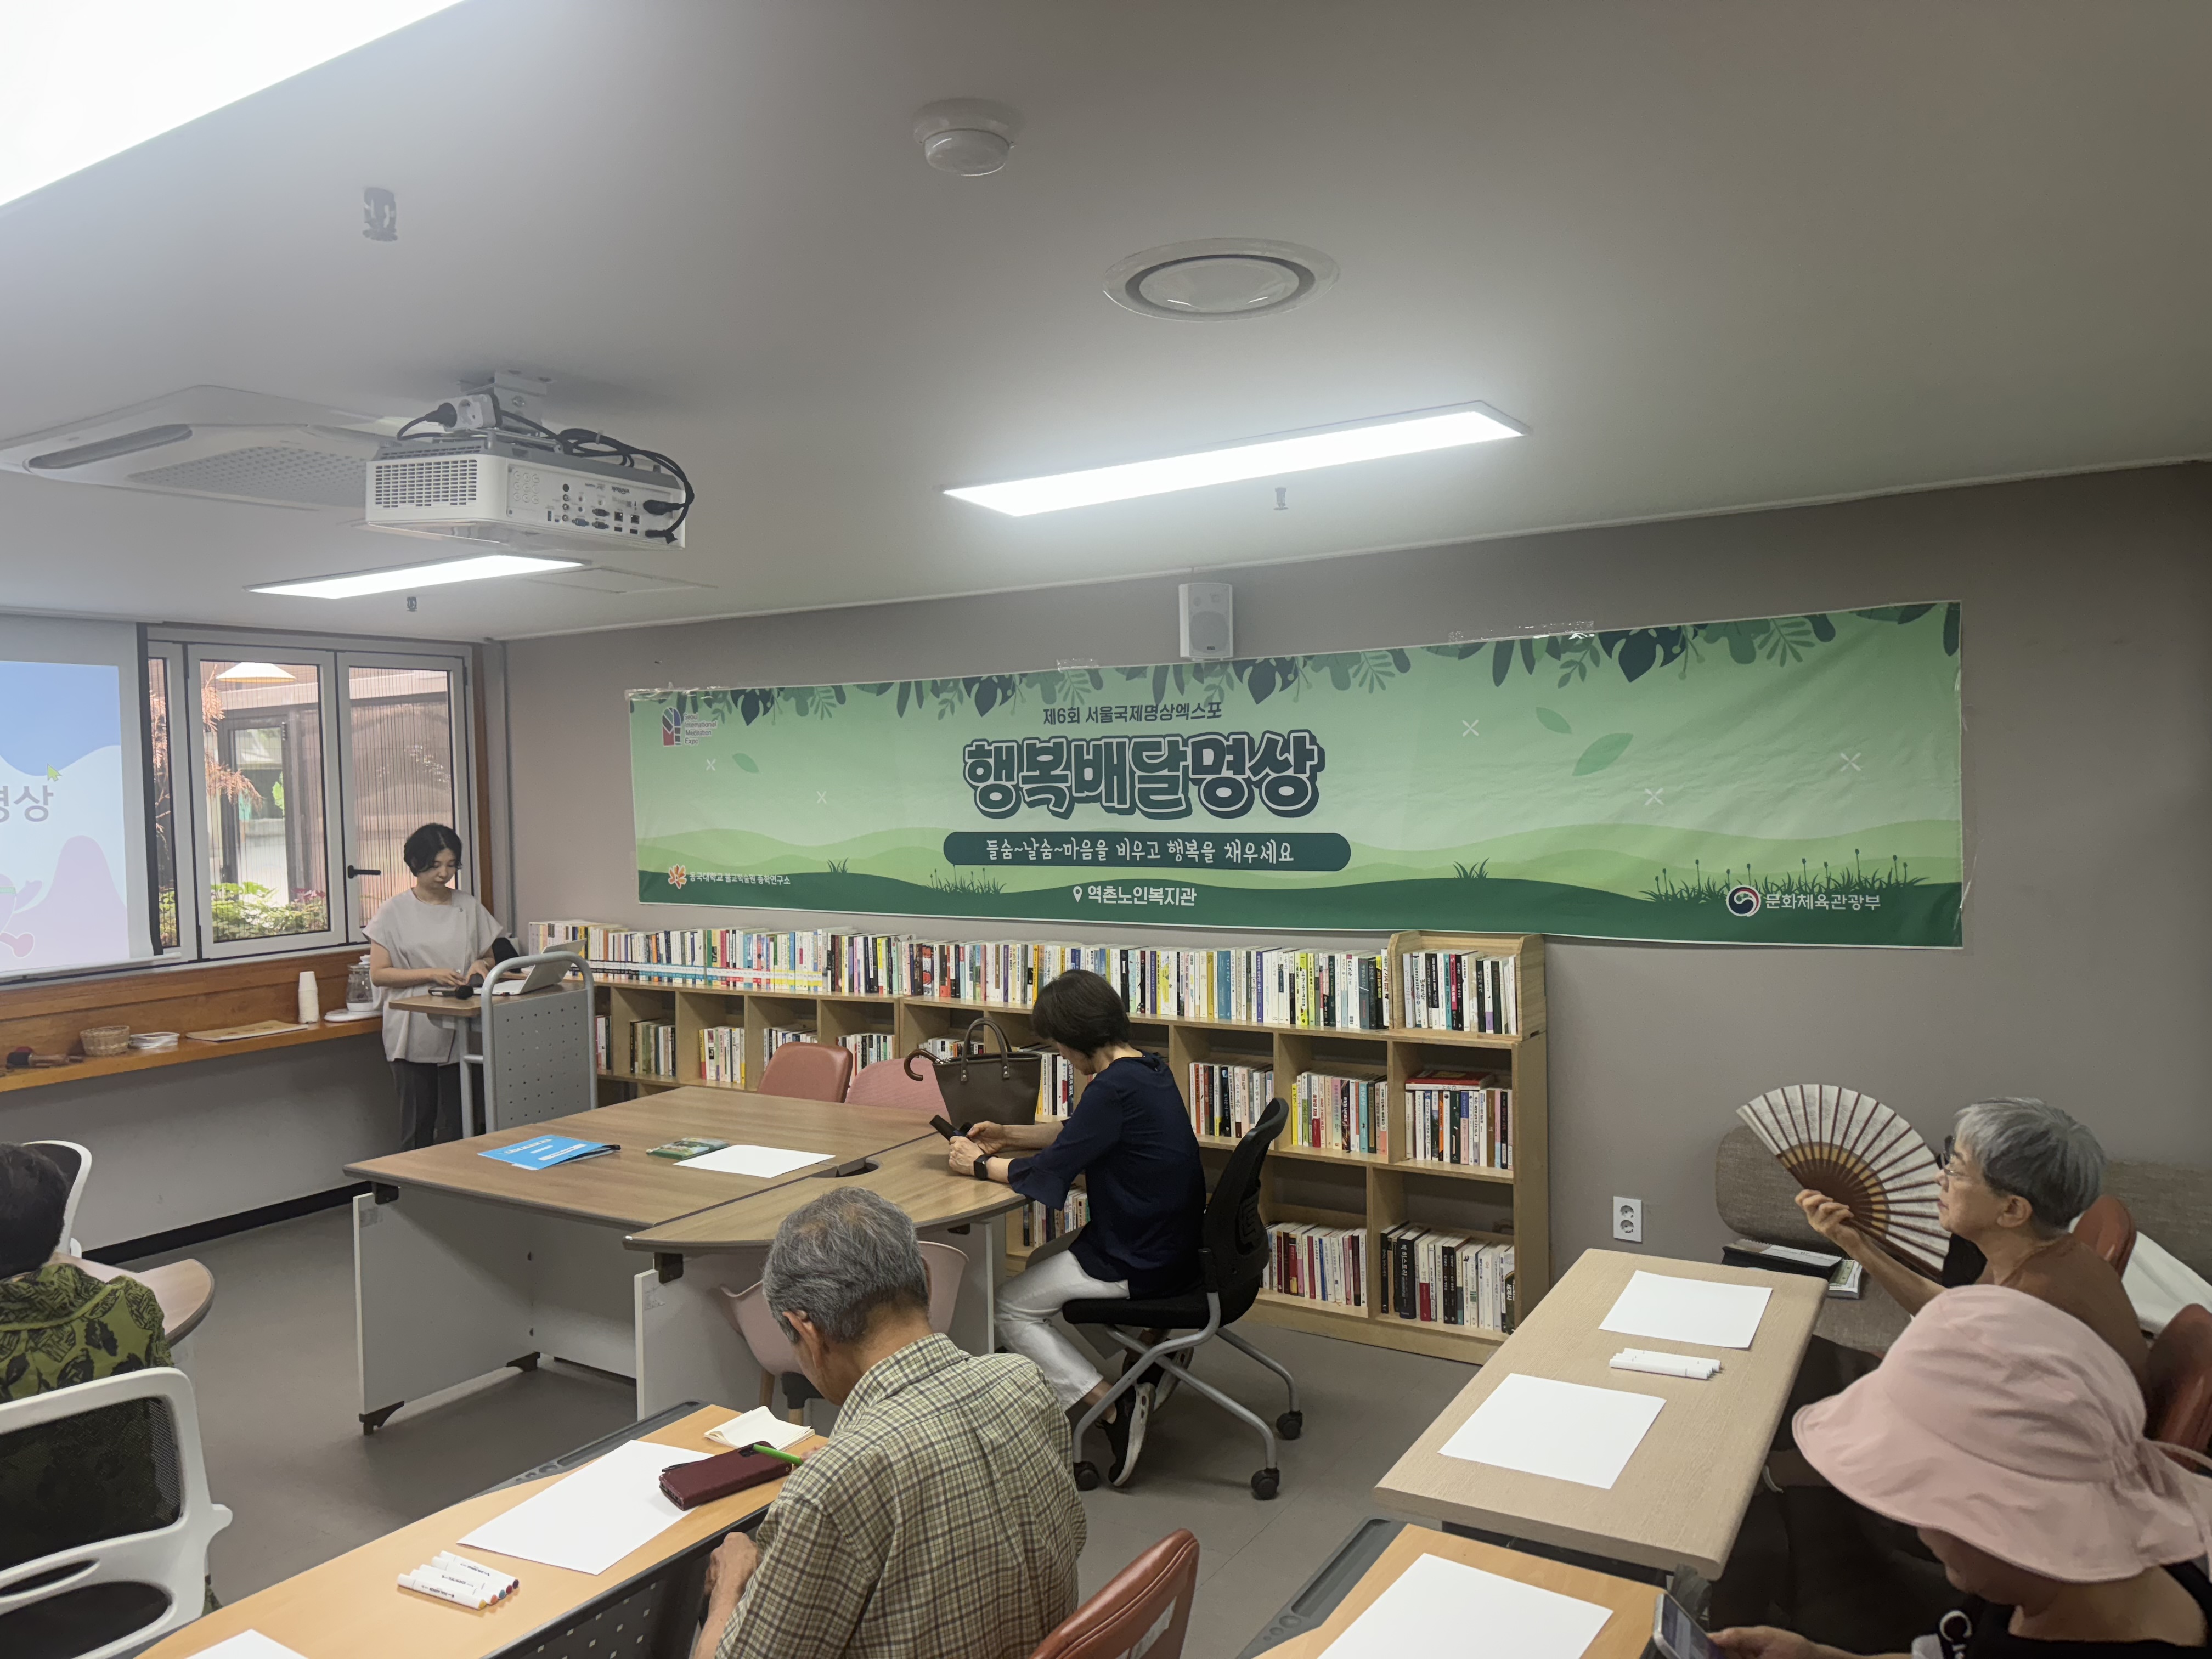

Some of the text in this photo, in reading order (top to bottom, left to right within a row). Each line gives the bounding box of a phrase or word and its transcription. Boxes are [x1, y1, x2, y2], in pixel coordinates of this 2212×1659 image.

[685, 720, 716, 728] International
[1043, 702, 1222, 725] 제6회 서울국제명상엑스포
[684, 737, 699, 746] Expo
[964, 731, 1323, 818] 행복배달명상
[986, 839, 1294, 864] 들숨~날숨~마음을 비우고 행복을 채우세요
[1087, 885, 1197, 907] 역촌노인복지관
[1765, 893, 1881, 911] 문화체육관광부
